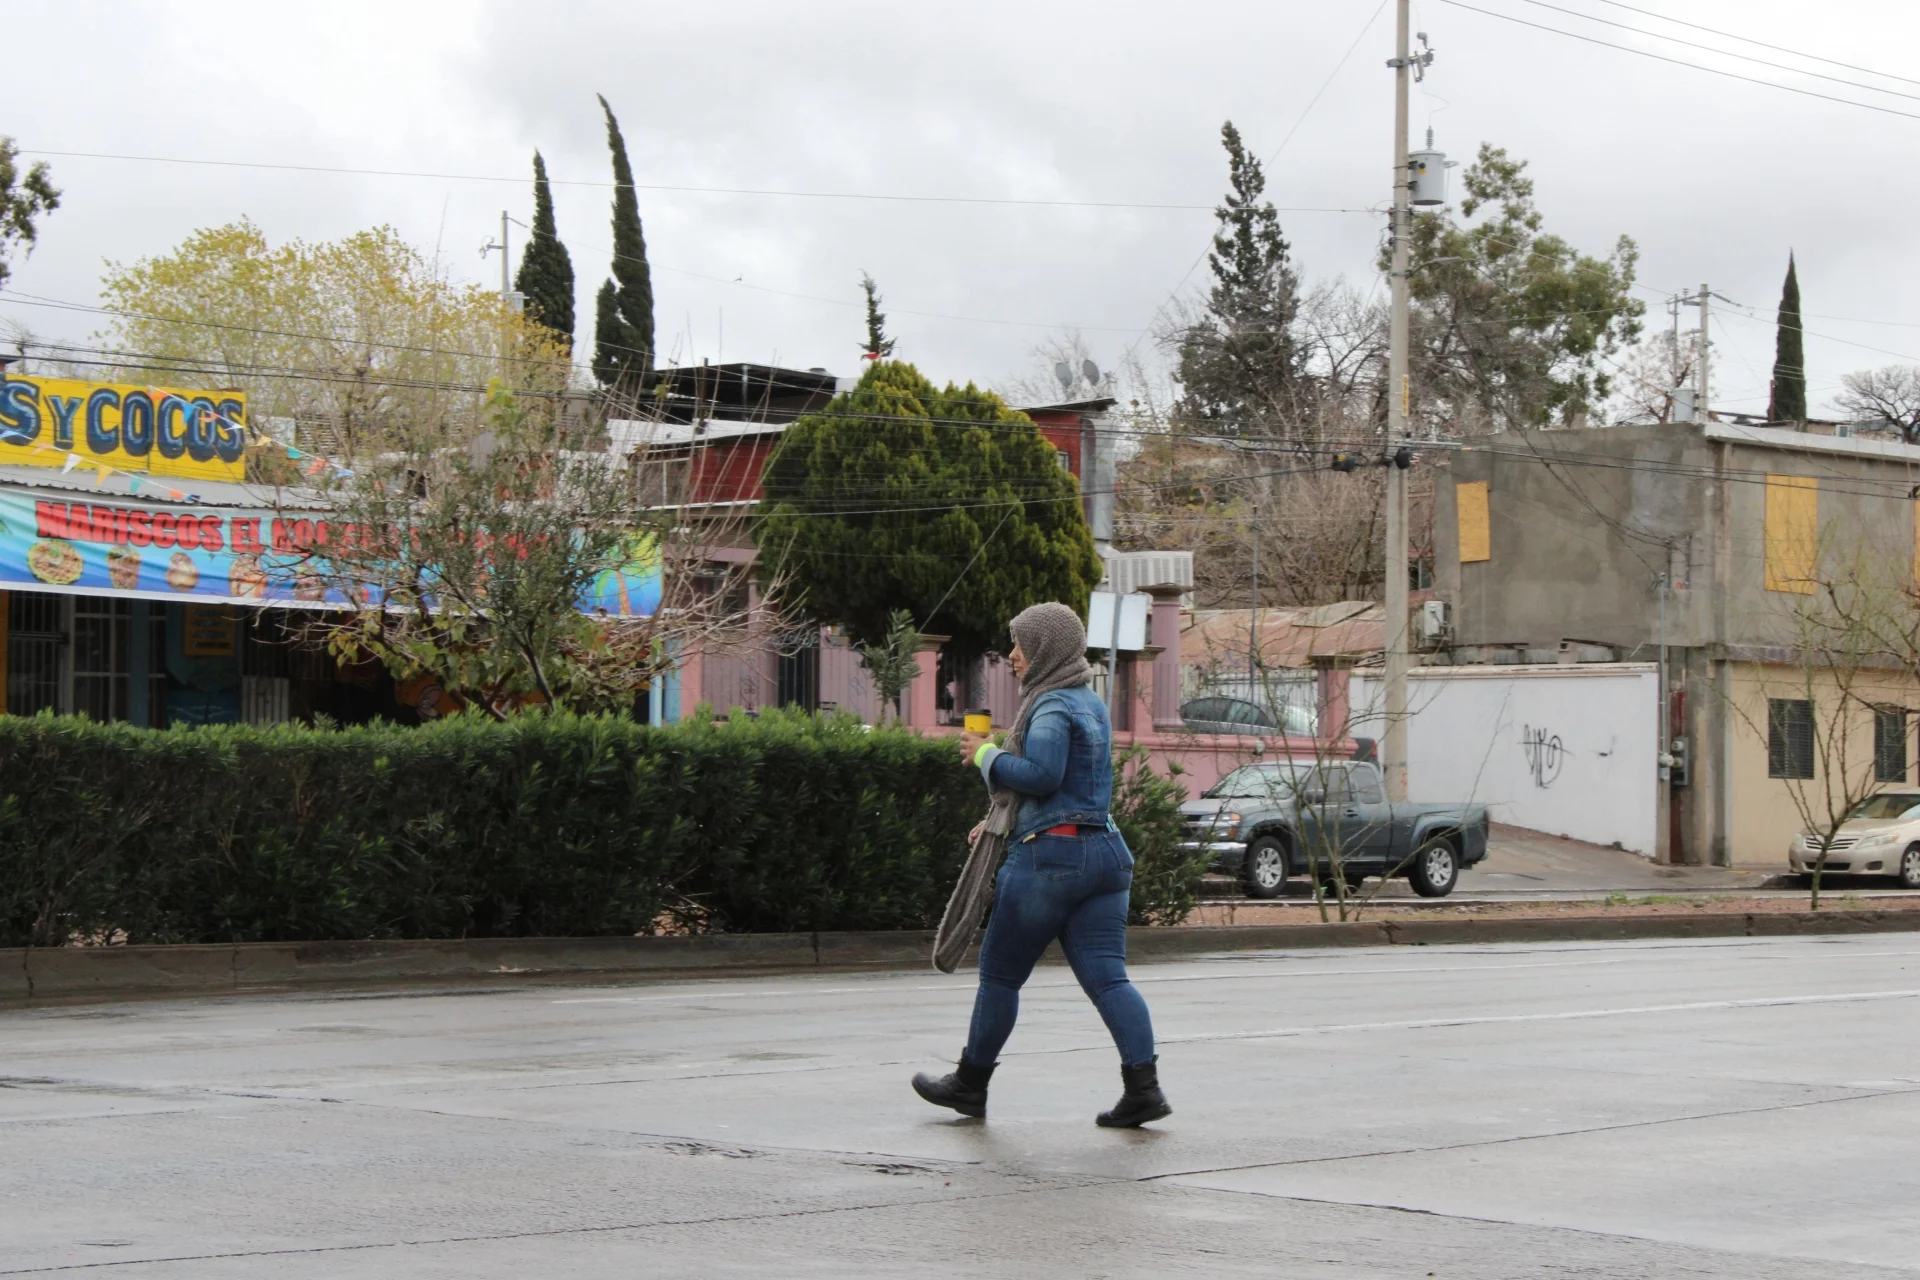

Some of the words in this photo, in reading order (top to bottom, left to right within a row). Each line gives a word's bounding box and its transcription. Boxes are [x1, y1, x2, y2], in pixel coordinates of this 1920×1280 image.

[87, 388, 245, 463] COCOS
[36, 501, 224, 551] MARISCOS
[231, 517, 261, 555] EL
